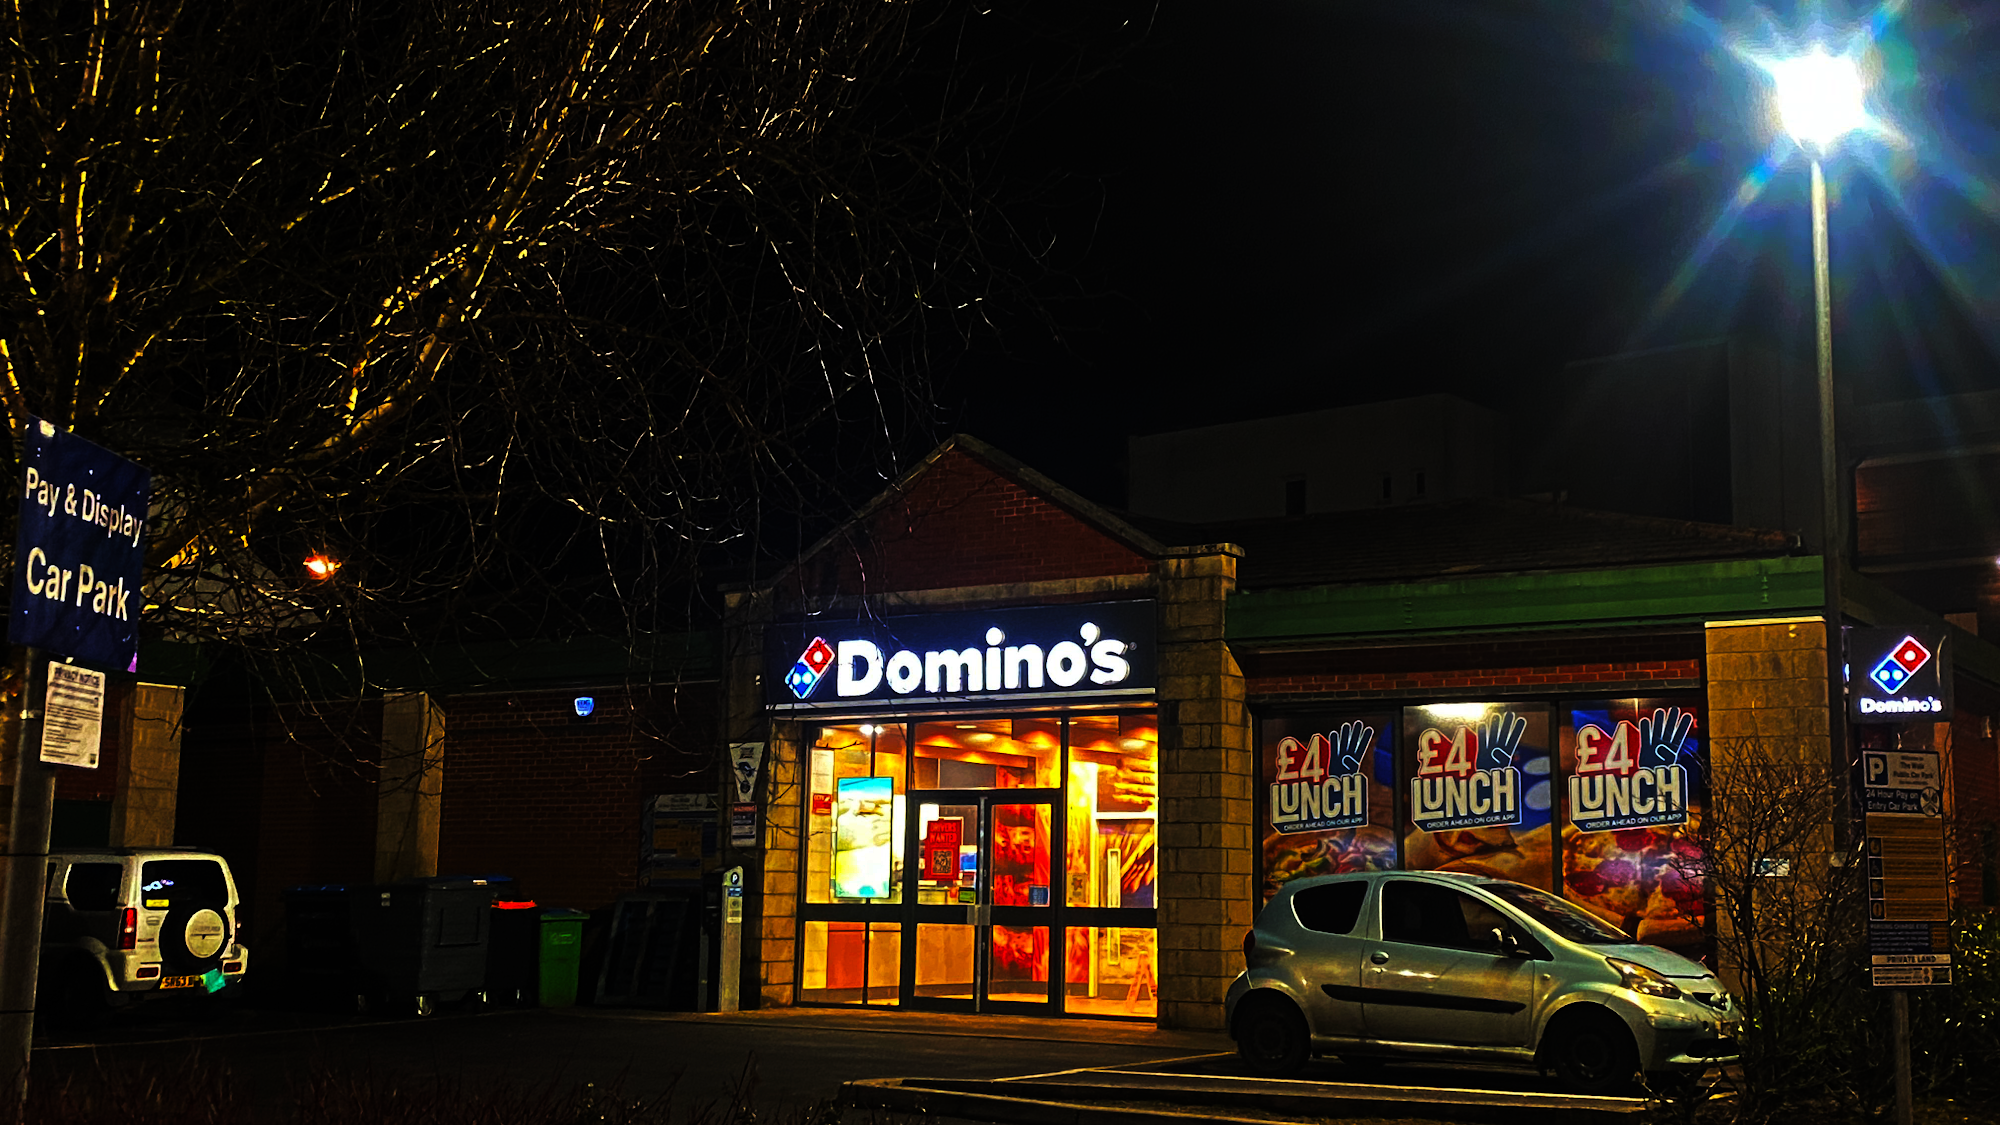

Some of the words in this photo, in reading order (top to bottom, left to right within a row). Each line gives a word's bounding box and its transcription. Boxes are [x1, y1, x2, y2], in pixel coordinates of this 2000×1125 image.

[25, 467, 60, 517] Pay
[65, 483, 77, 517] &
[82, 489, 143, 547] Display
[26, 547, 72, 603] Car
[76, 564, 130, 622] Park
[837, 622, 1130, 697] Domino's
[1860, 696, 1942, 714] Domino's
[1278, 736, 1324, 782] £4
[1420, 727, 1471, 776] £4
[1578, 723, 1633, 775] £4
[1869, 757, 1885, 782] P
[1272, 775, 1362, 823] LUNCH
[1414, 769, 1514, 821] LUNCH
[1572, 766, 1680, 821] LUNCH
[1866, 789, 1876, 798] 24
[1877, 789, 1894, 798] Hour
[1896, 790, 1908, 801] Pay
[1867, 801, 1887, 811] Entry
[1888, 801, 1900, 810] Car
[1902, 802, 1919, 811] Park
[930, 822, 957, 832] DRIVERS
[1305, 821, 1325, 829] AHEAD
[1336, 818, 1350, 826] OUR
[1427, 821, 1449, 829] ORDER
[1450, 819, 1473, 827] AHEAD
[1486, 815, 1500, 823] OUR
[1585, 820, 1611, 829] ORDER
[1612, 817, 1636, 826] AHEAD
[1637, 816, 1649, 824] ON
[1666, 813, 1682, 821] APP
[930, 832, 957, 843] WANTED
[1917, 955, 1936, 963] LAND
